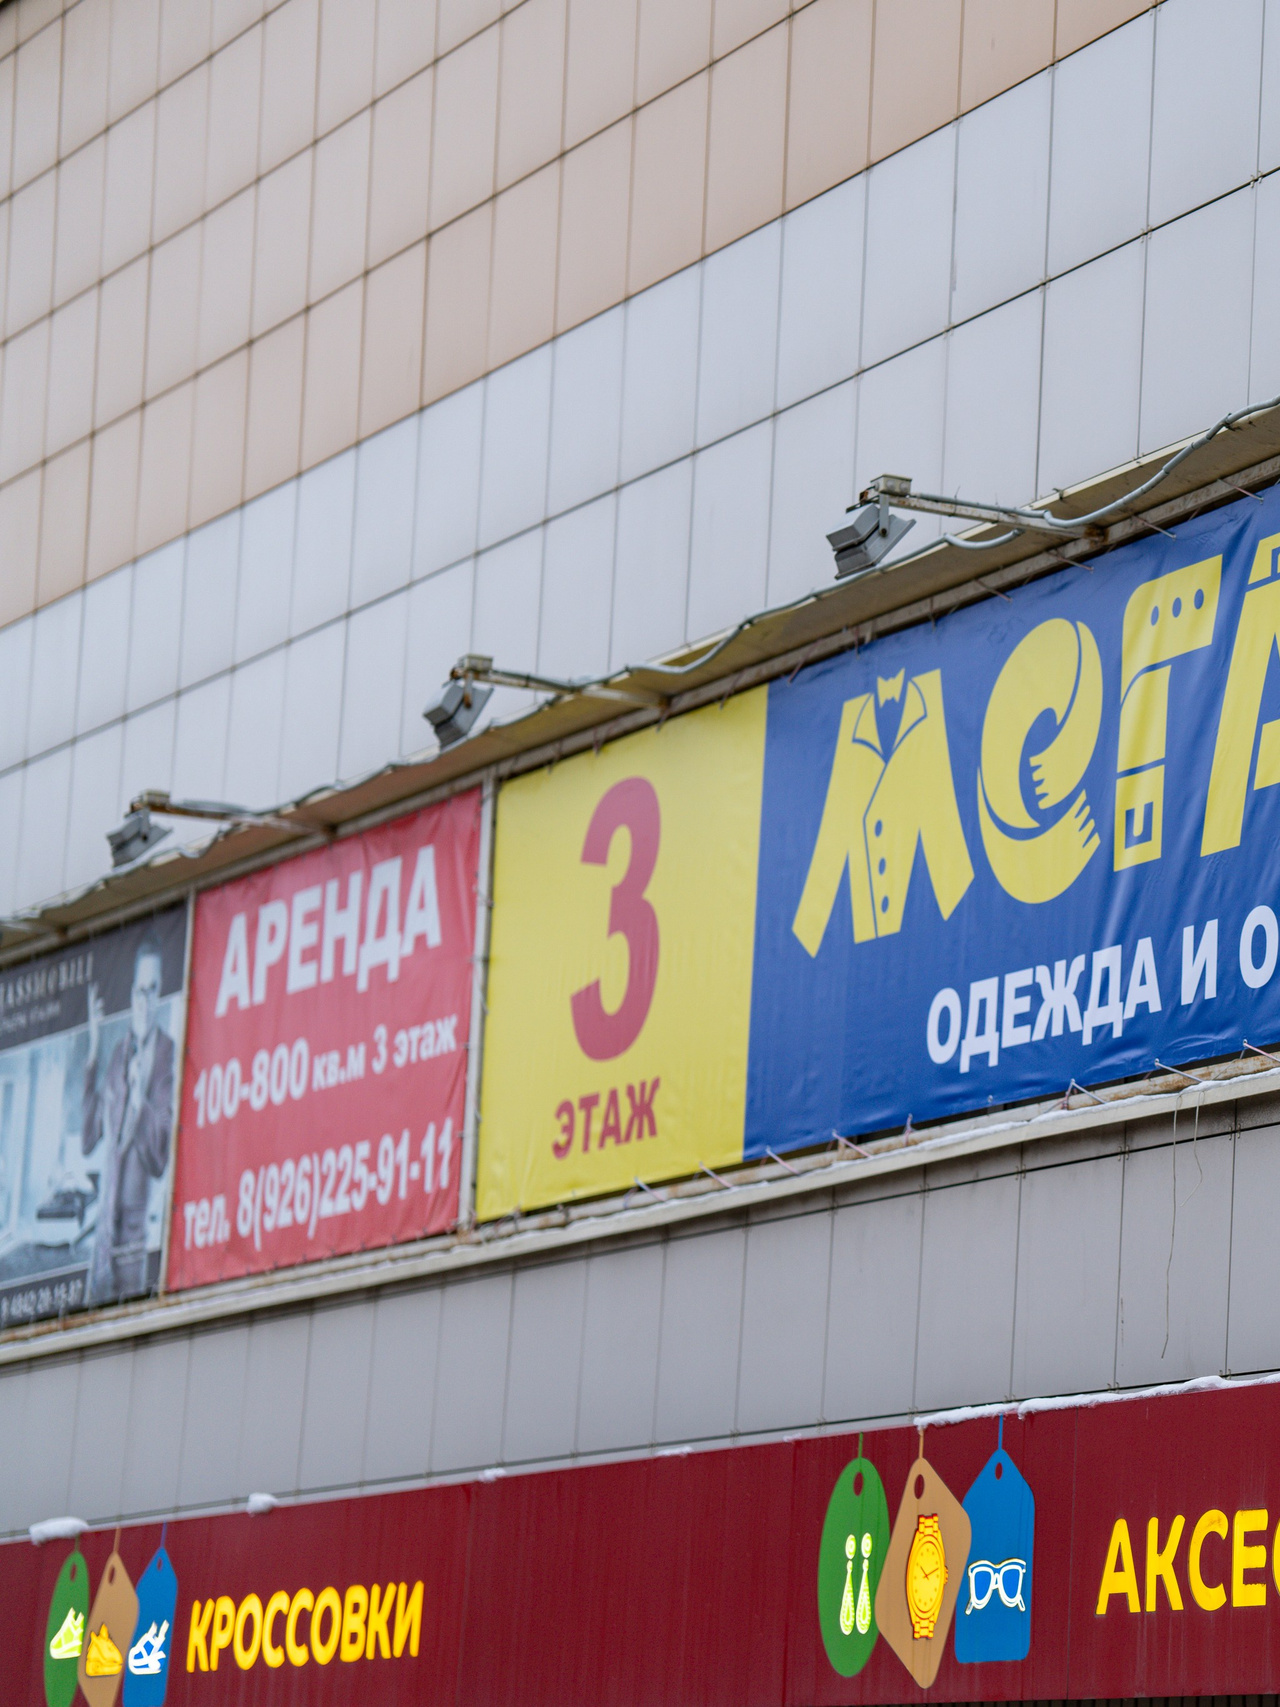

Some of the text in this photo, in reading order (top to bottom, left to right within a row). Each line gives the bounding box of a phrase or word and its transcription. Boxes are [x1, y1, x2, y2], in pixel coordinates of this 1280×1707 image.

[214, 843, 443, 1018] АРЕНДА
[570, 775, 661, 1062] 3
[926, 936, 1162, 1074] ОДЕЖДА
[1180, 918, 1219, 1006] И
[193, 1013, 458, 1129] 100-800 кв.м 3 этаж
[550, 1076, 661, 1162] ЭТАЖ
[183, 1116, 454, 1252] тел. 8(926)225-91-11
[186, 1580, 425, 1673] КРОССОВКИ
